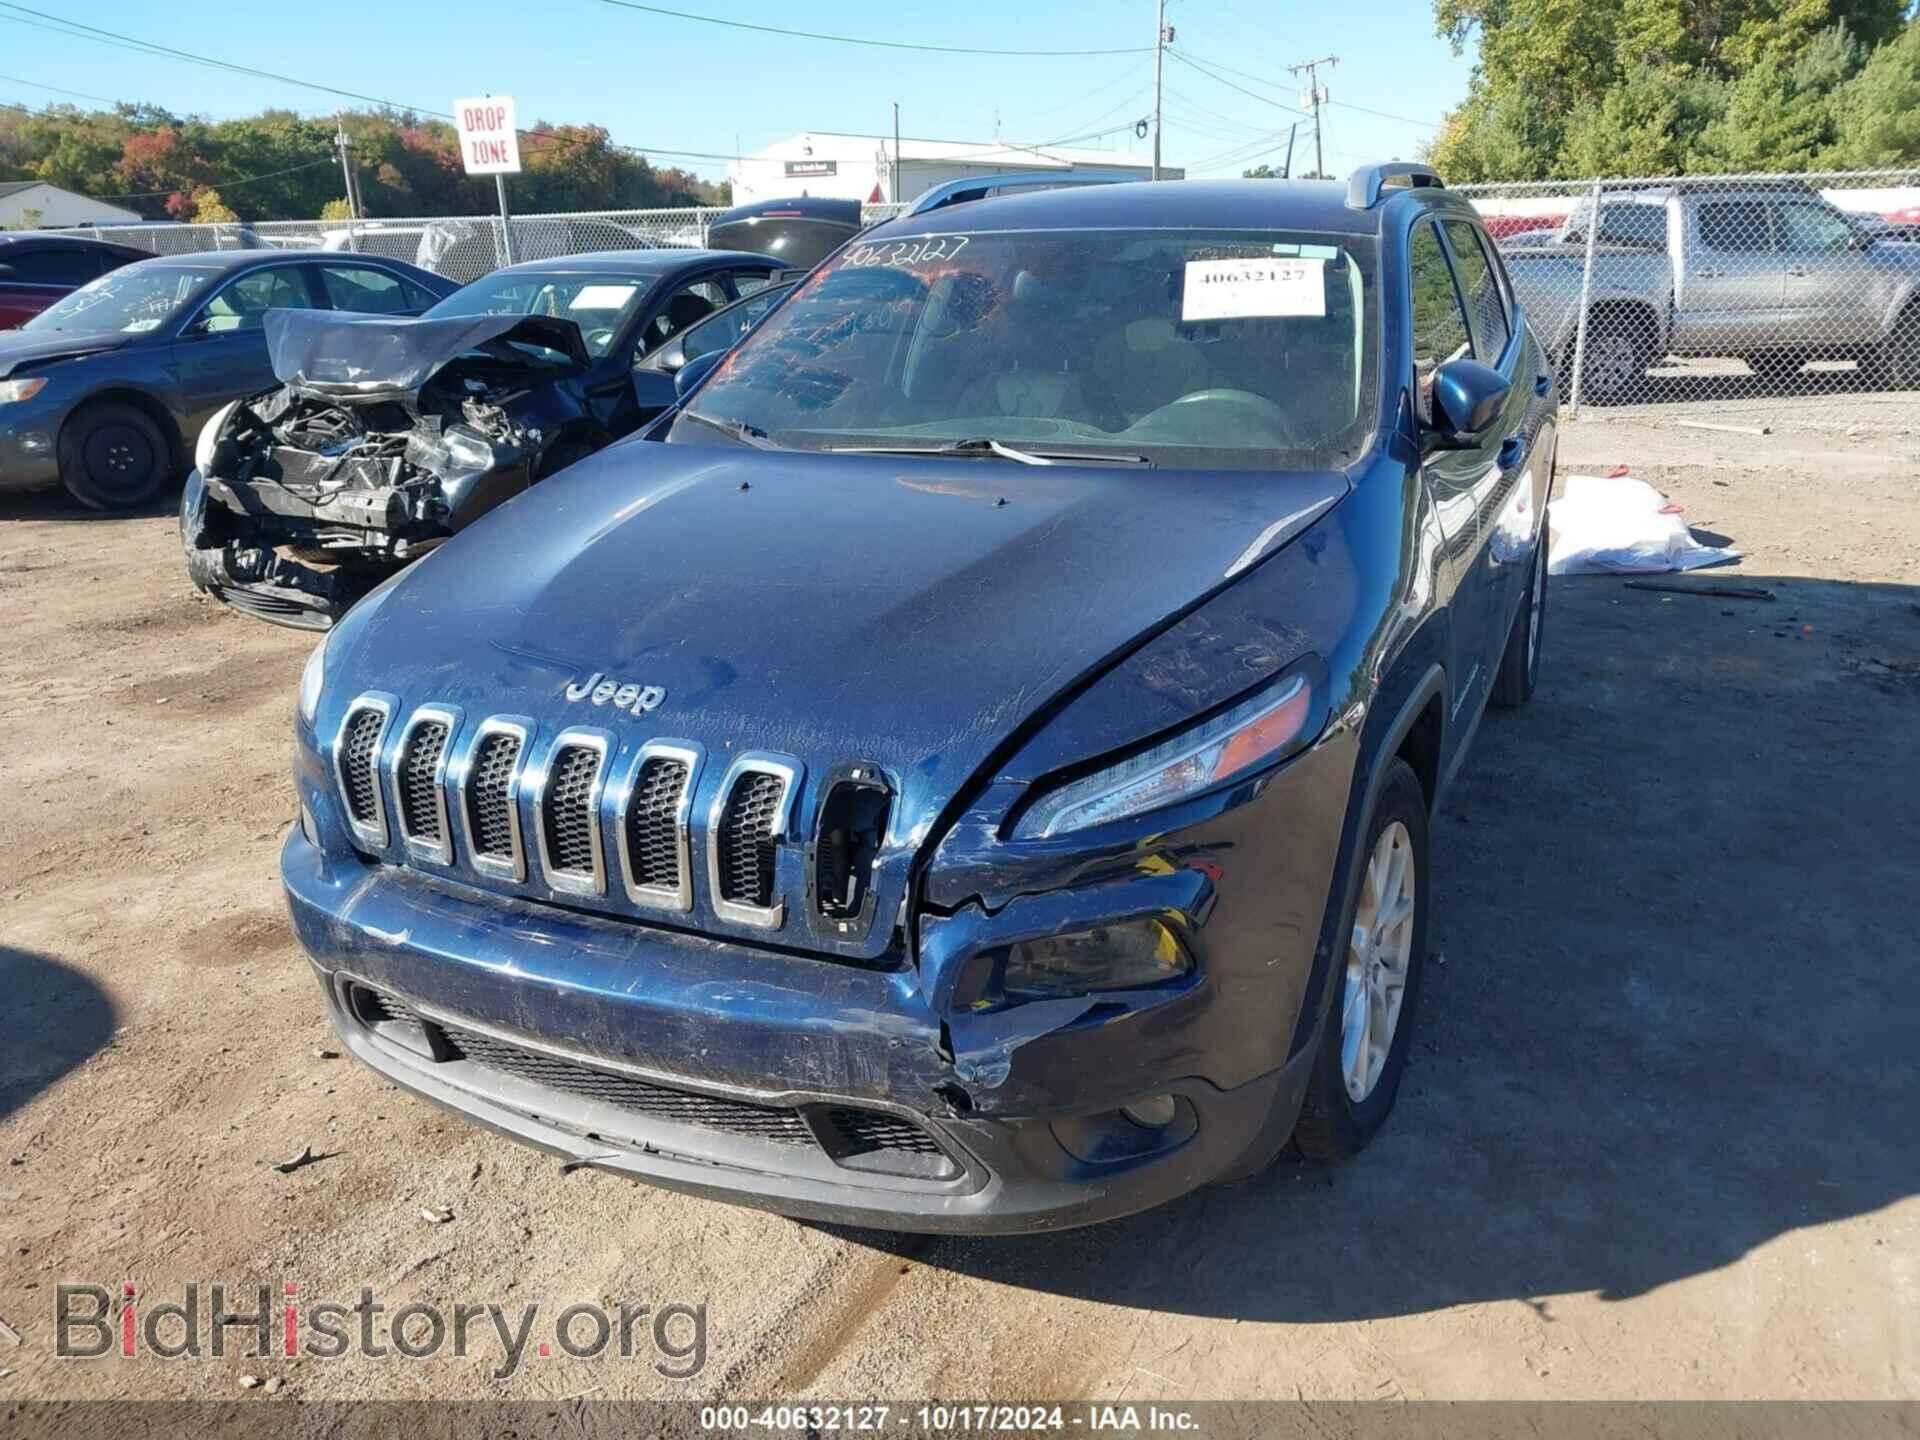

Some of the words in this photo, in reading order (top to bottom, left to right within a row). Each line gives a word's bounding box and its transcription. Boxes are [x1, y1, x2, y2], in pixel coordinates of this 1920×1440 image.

[464, 106, 505, 132] DROP
[472, 140, 508, 164] ZONE
[840, 236, 969, 270] 40632127
[1198, 269, 1305, 284] 40632127
[566, 672, 666, 716] Jeep
